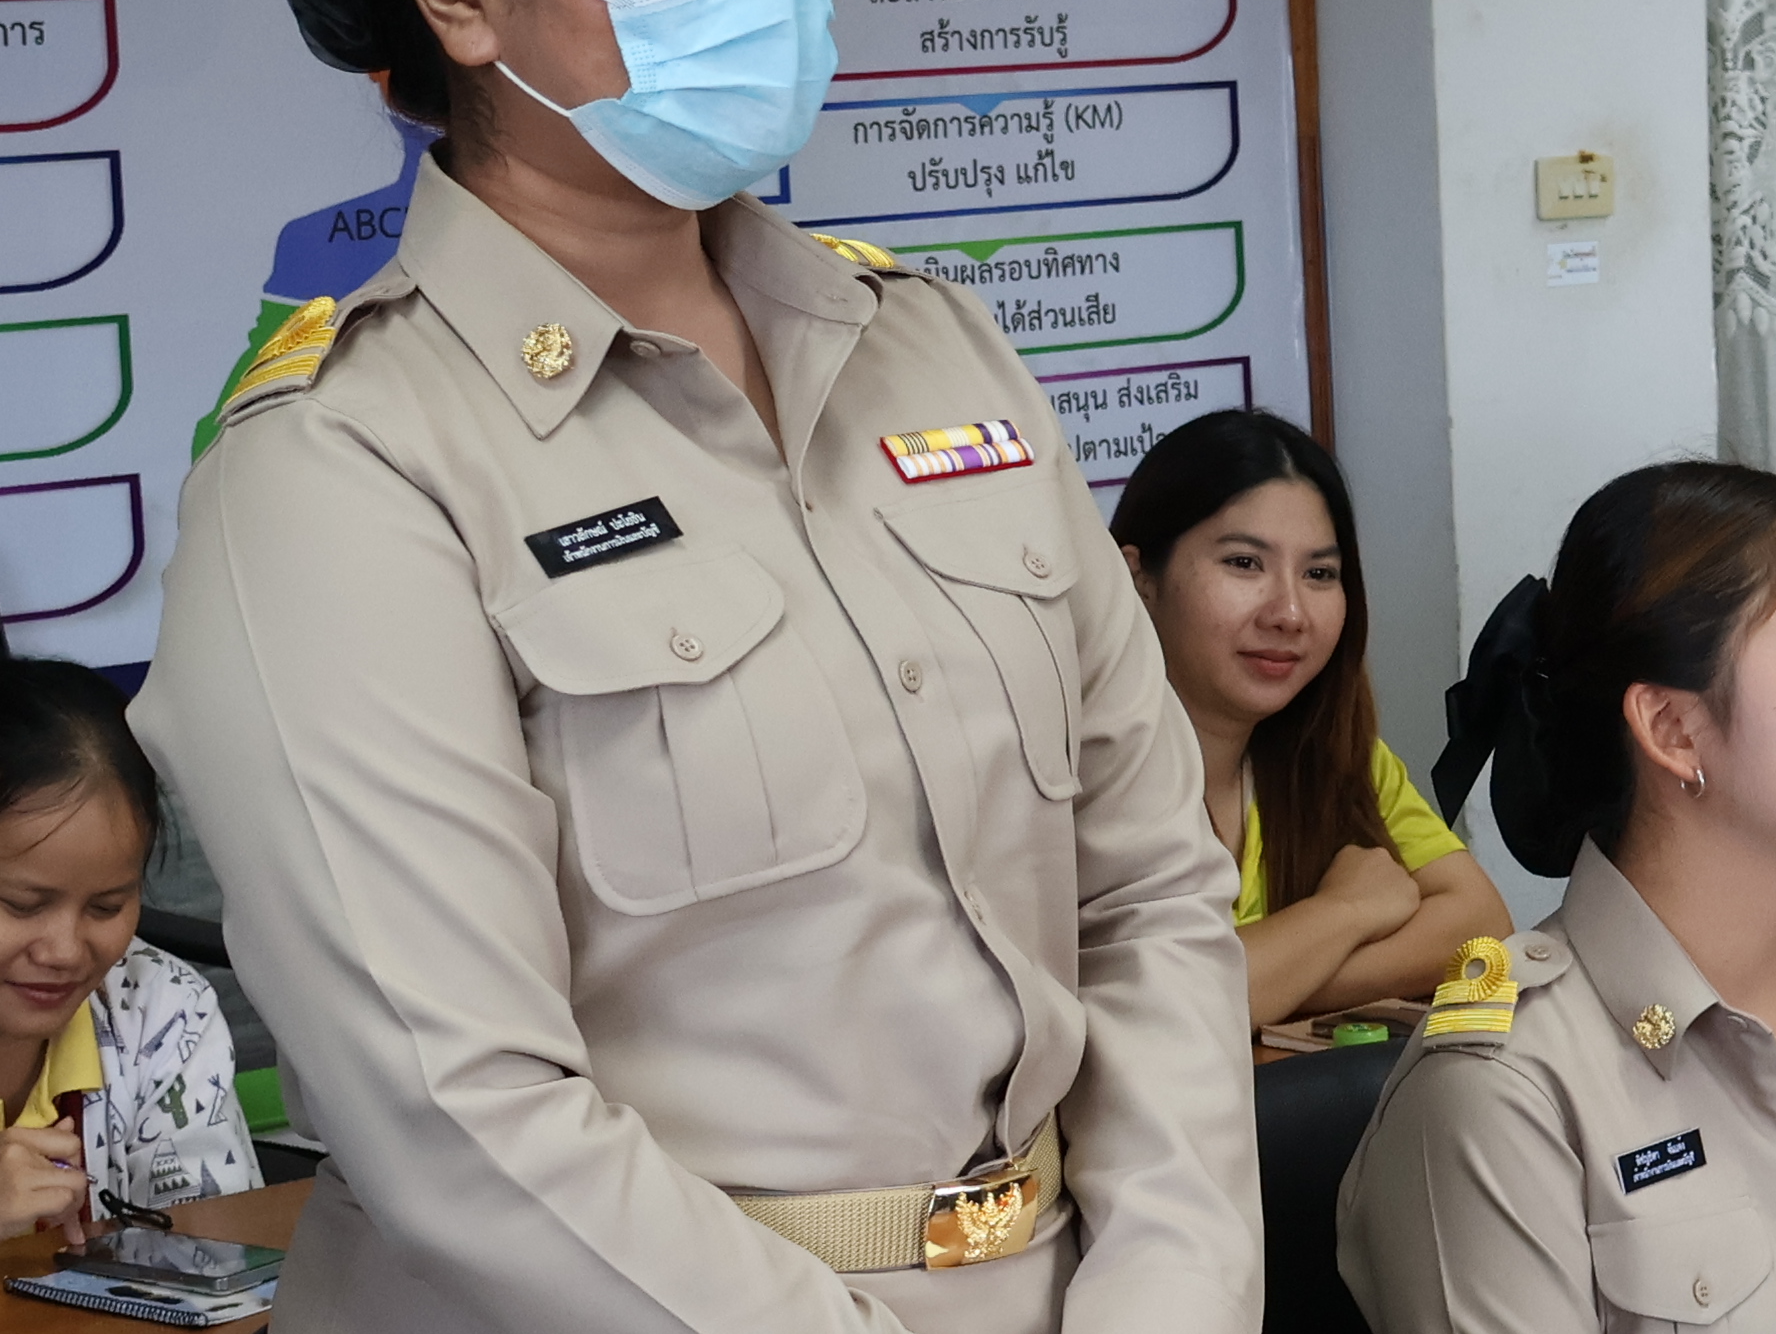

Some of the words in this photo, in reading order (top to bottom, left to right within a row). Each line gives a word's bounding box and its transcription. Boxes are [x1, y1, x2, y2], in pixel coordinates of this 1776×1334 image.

[921, 13, 1070, 60] สร้างการรับรู้
[853, 100, 1056, 146] การจัดการความรู้
[1065, 100, 1124, 133] (KM)
[908, 162, 1006, 197] ปรับปรุง
[1016, 155, 1076, 187] แก้ไข
[328, 207, 410, 243] ABC
[993, 292, 1117, 335] ได้ส่วนเสีย
[1049, 388, 1109, 423] สนุน
[1117, 373, 1200, 409] ส่งเสริม
